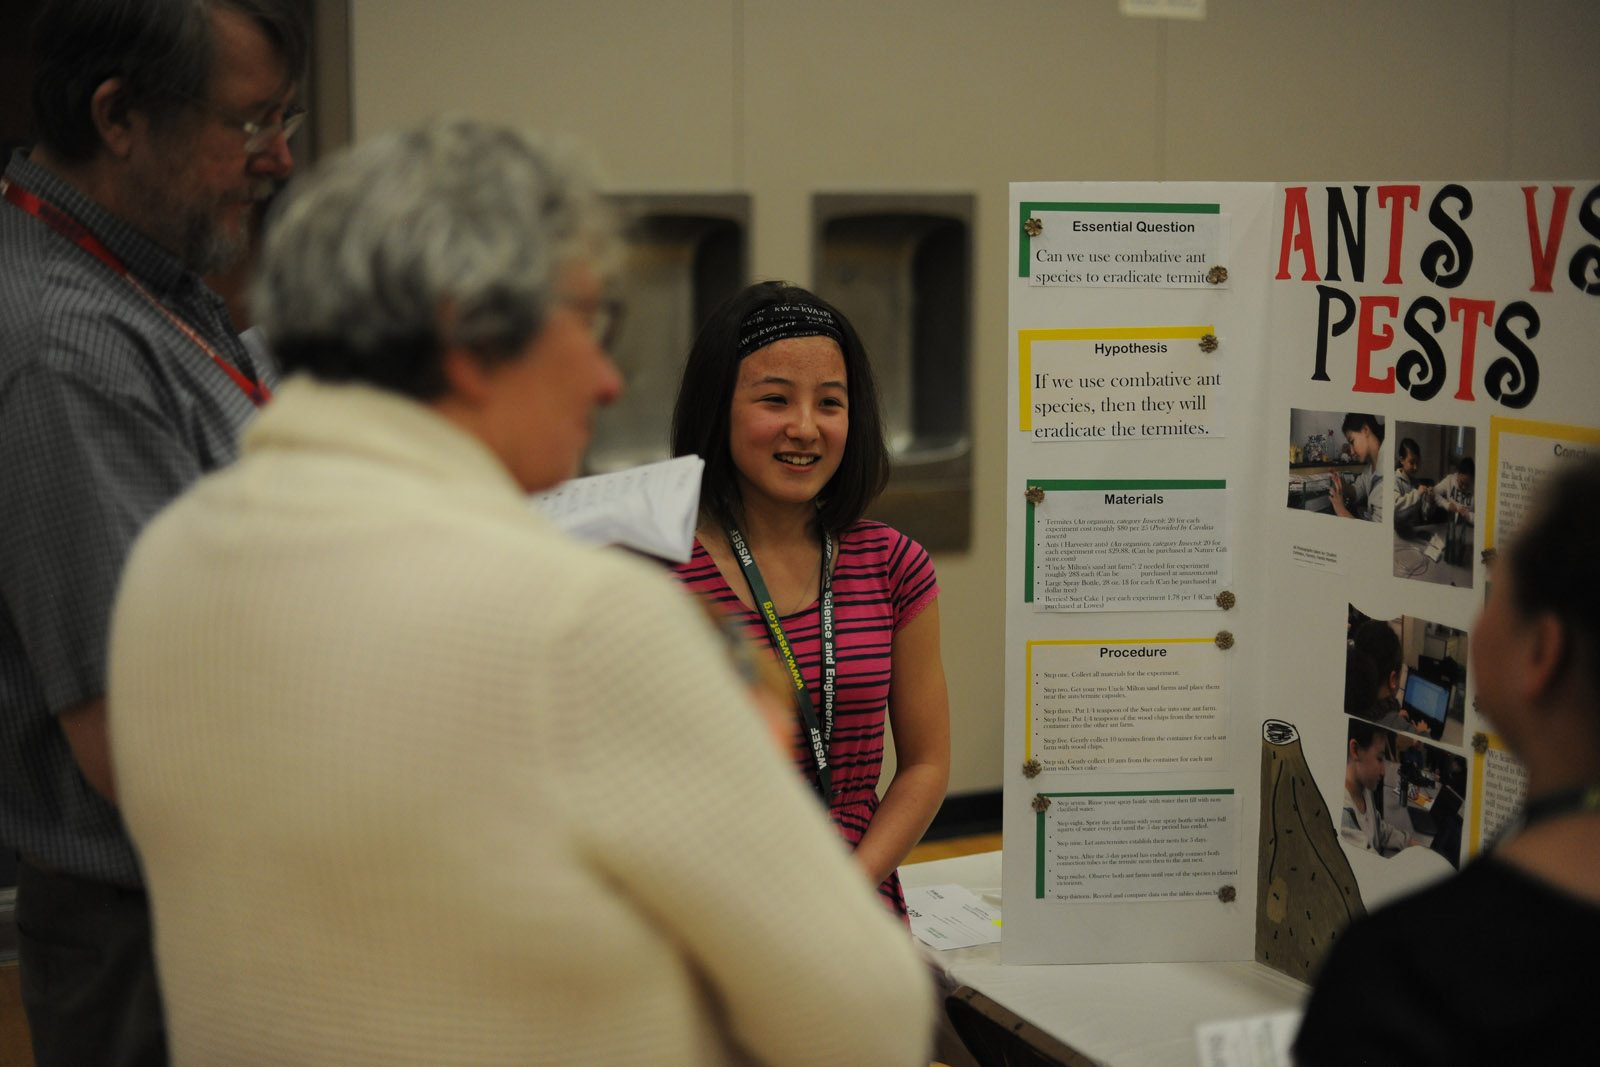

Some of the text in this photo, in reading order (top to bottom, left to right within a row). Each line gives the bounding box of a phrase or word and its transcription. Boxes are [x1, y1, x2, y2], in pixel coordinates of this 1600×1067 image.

[1072, 221, 1195, 233] Essential Question
[1275, 184, 1474, 288] ANTS
[1036, 250, 1206, 263] Can we use combative ant
[1035, 272, 1082, 286] species
[1086, 273, 1099, 283] to
[1103, 272, 1162, 283] eradicate
[1094, 343, 1168, 356] Hypothesis
[1311, 285, 1540, 409] PESTS
[1035, 372, 1221, 388] If we use combative ant
[1034, 395, 1206, 416] species, then they will
[1034, 420, 1208, 438] eradicate the termites.
[1104, 494, 1164, 504] Materials
[1094, 525, 1115, 533] roughly
[730, 529, 752, 567] WSSEF
[1060, 548, 1093, 556] experiment
[1156, 547, 1185, 555] purchased
[1045, 571, 1067, 579] roughly
[1140, 570, 1170, 578] purchased
[1180, 578, 1209, 586] purchased
[1045, 602, 1075, 610] purchased
[824, 590, 832, 639] Science
[763, 600, 804, 690] www.wssef.org
[825, 642, 835, 665] and
[1100, 647, 1167, 658] Procedure
[1044, 686, 1057, 694] Step
[823, 668, 835, 741] Engineering
[810, 728, 826, 770] WSSEF
